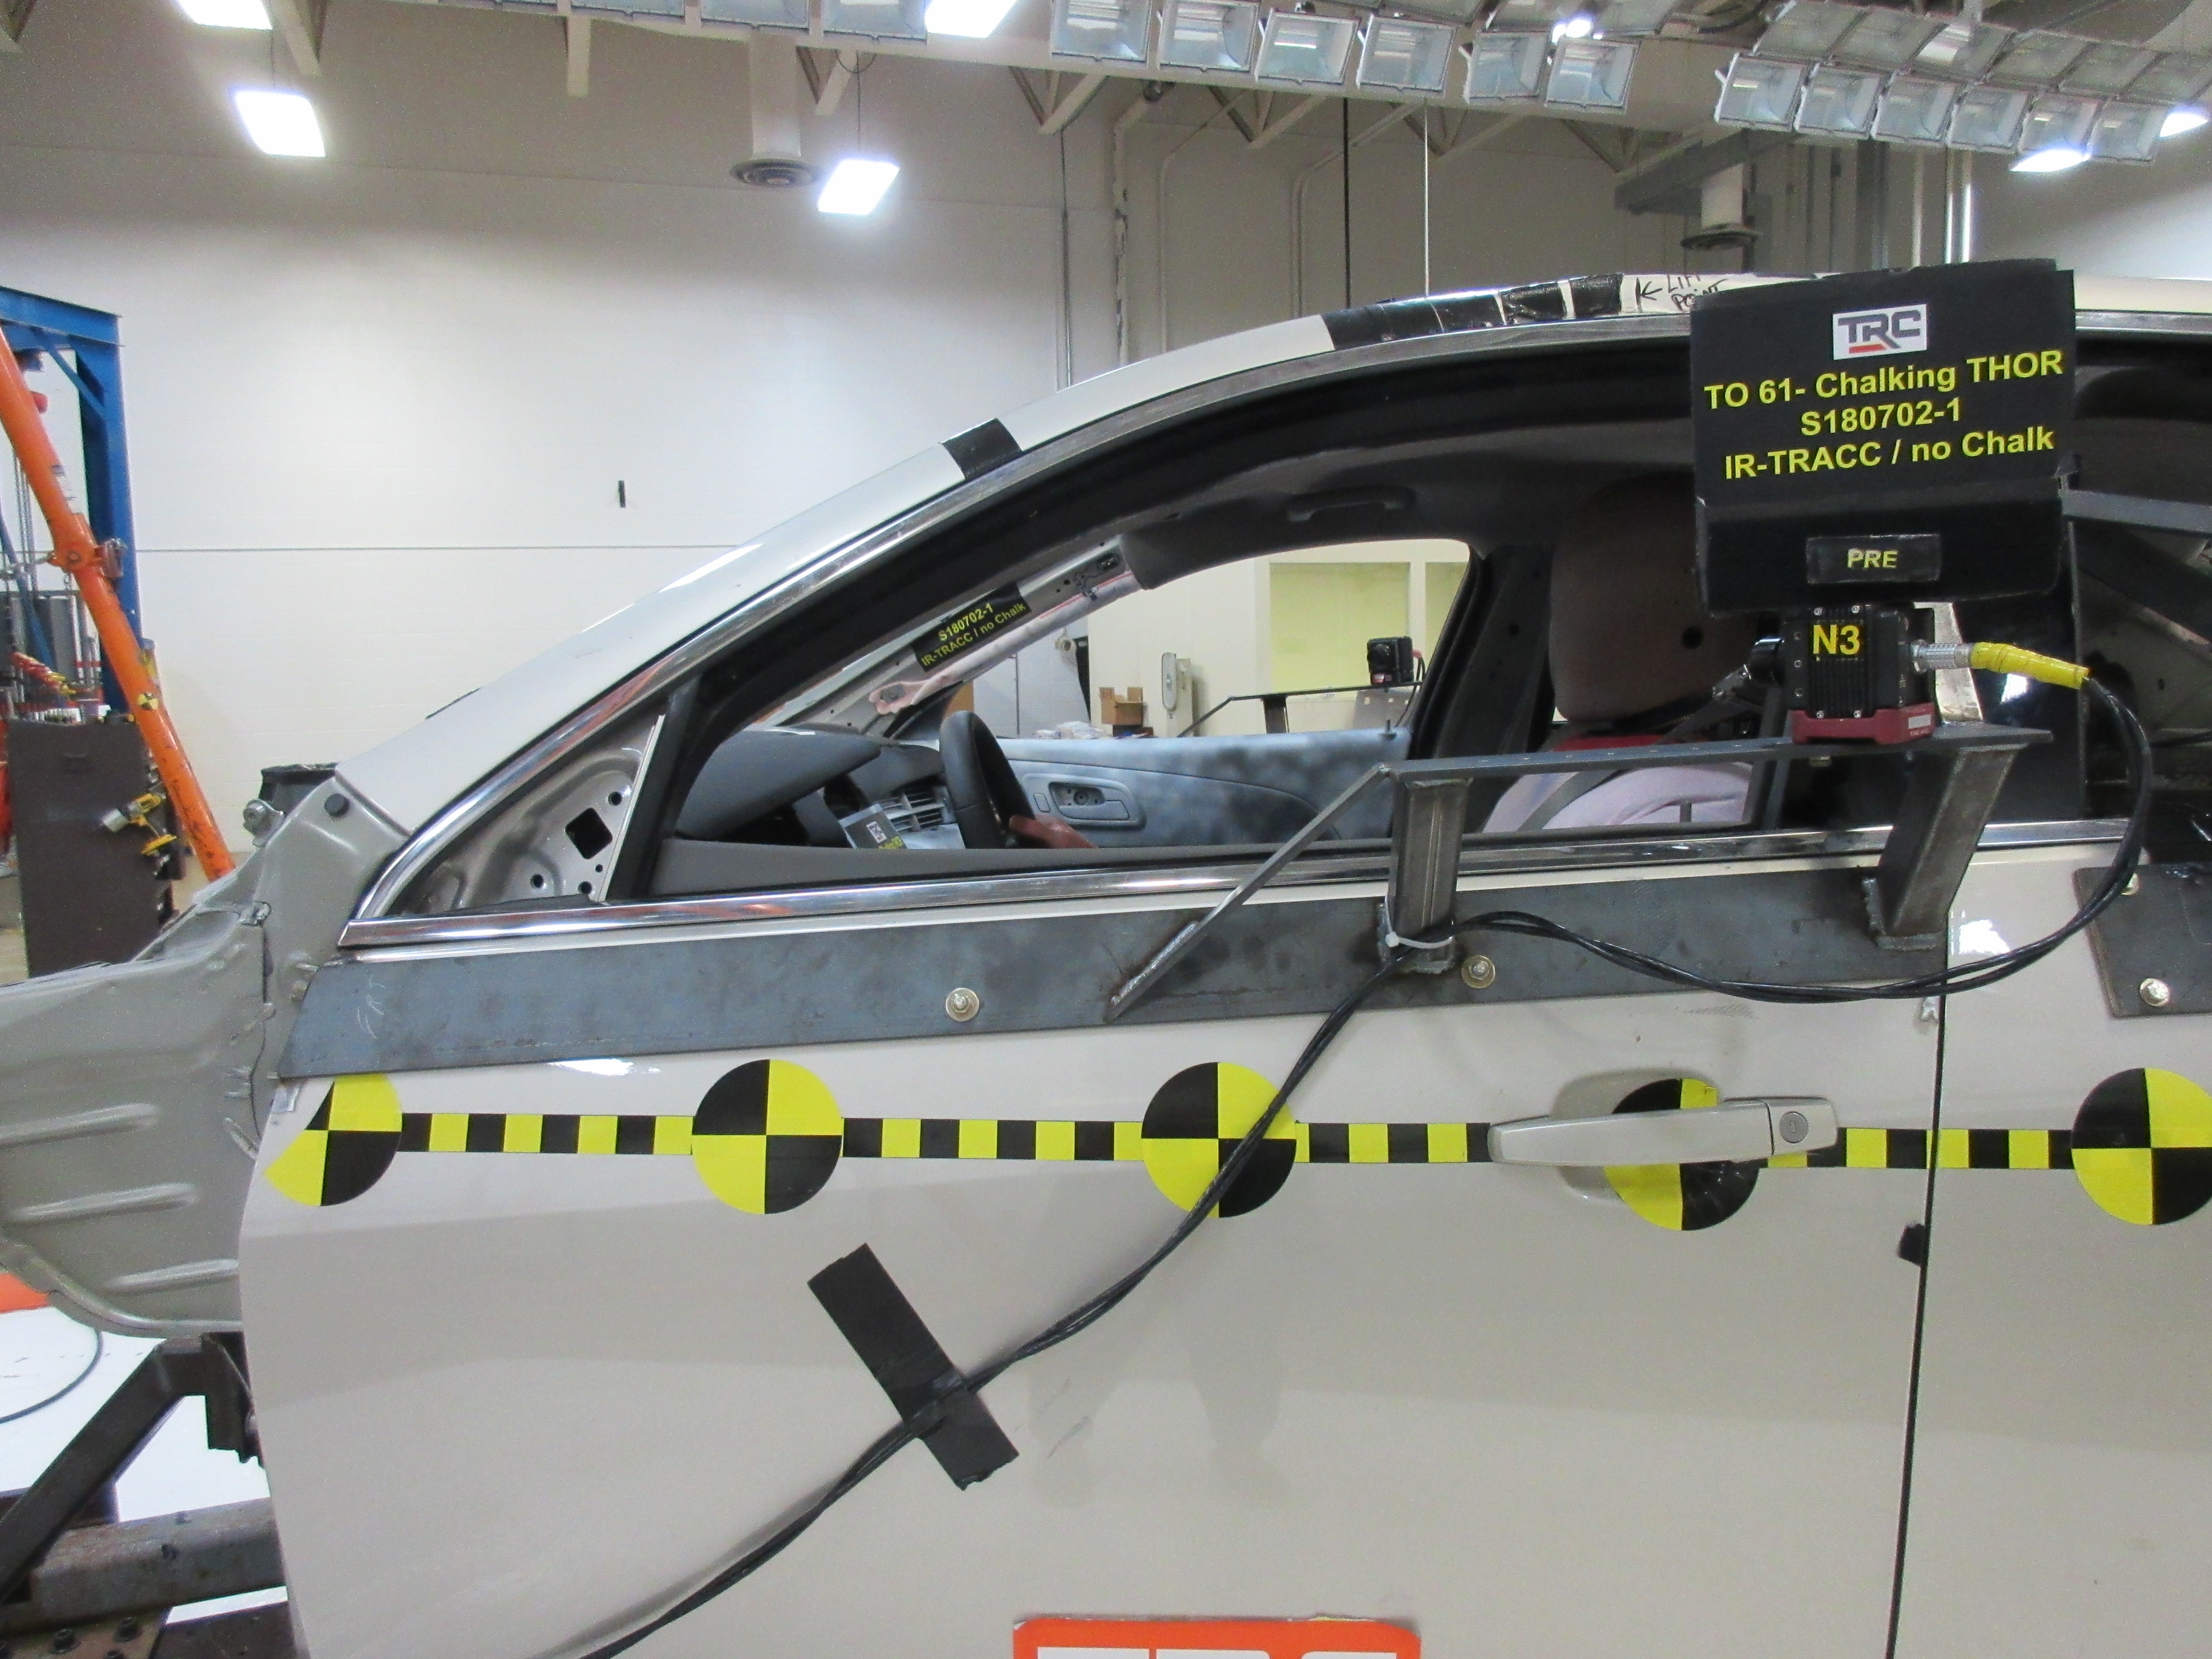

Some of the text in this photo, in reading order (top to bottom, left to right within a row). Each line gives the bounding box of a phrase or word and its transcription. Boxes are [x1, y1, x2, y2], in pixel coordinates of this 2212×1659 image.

[1838, 310, 1922, 349] TRC
[1704, 350, 2063, 409] TO 61- Chalking THOR
[1801, 397, 1960, 436] S180702-1
[1726, 426, 2054, 479] IR-TRACC / no Chalk
[1848, 548, 1898, 568] PRE
[921, 632, 973, 666] IR-TRACC
[980, 622, 995, 634] no
[995, 603, 1026, 624] Chalk
[938, 603, 994, 641] S180702-1
[1813, 624, 1860, 655] N3
